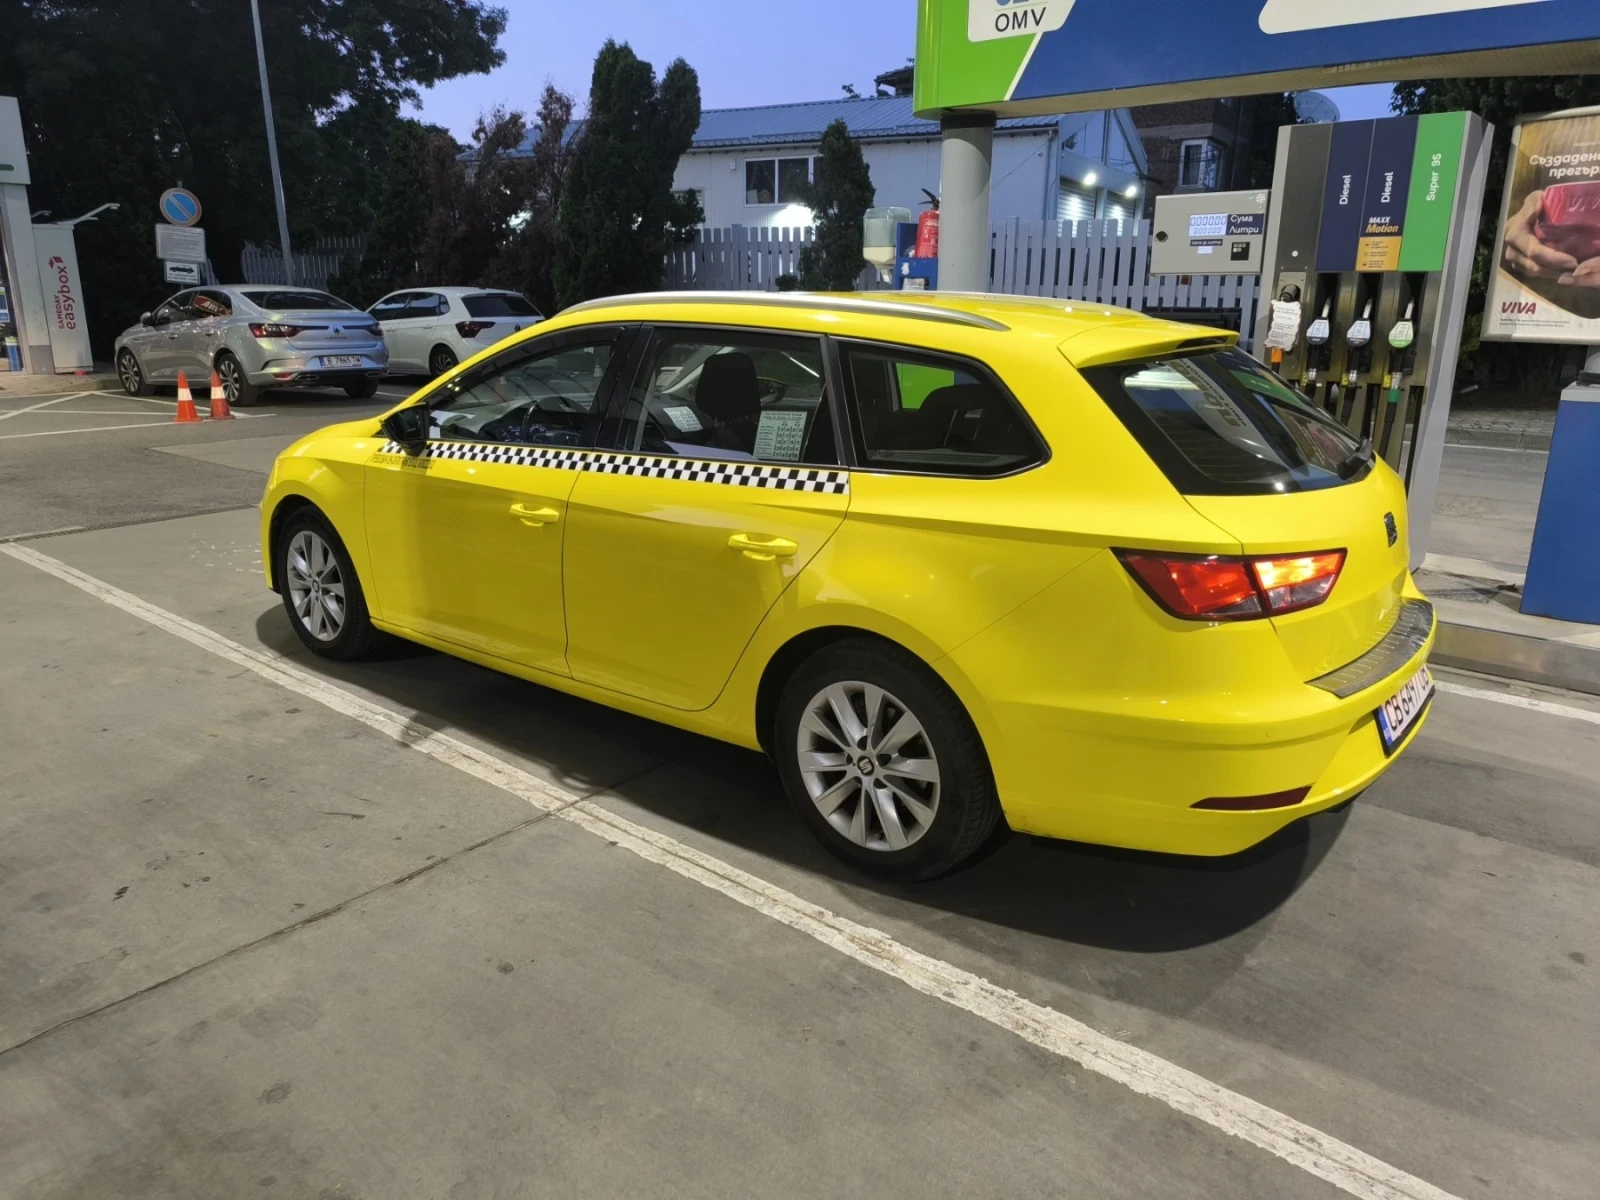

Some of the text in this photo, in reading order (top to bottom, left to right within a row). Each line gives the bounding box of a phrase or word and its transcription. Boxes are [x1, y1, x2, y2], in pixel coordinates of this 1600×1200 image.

[995, 7, 1047, 32] OMV
[1426, 153, 1442, 201] Super 95
[1549, 166, 1600, 179] прегър
[1339, 174, 1352, 205] Diesel
[1381, 171, 1394, 203] Diesel
[1230, 214, 1253, 224] Сума
[1365, 224, 1399, 233] Motion
[1369, 216, 1391, 224] MAXX
[57, 265, 76, 330] easybox
[1501, 301, 1537, 315] VIVA
[54, 294, 65, 330] SAMEDAY
[1385, 694, 1403, 731] CB
